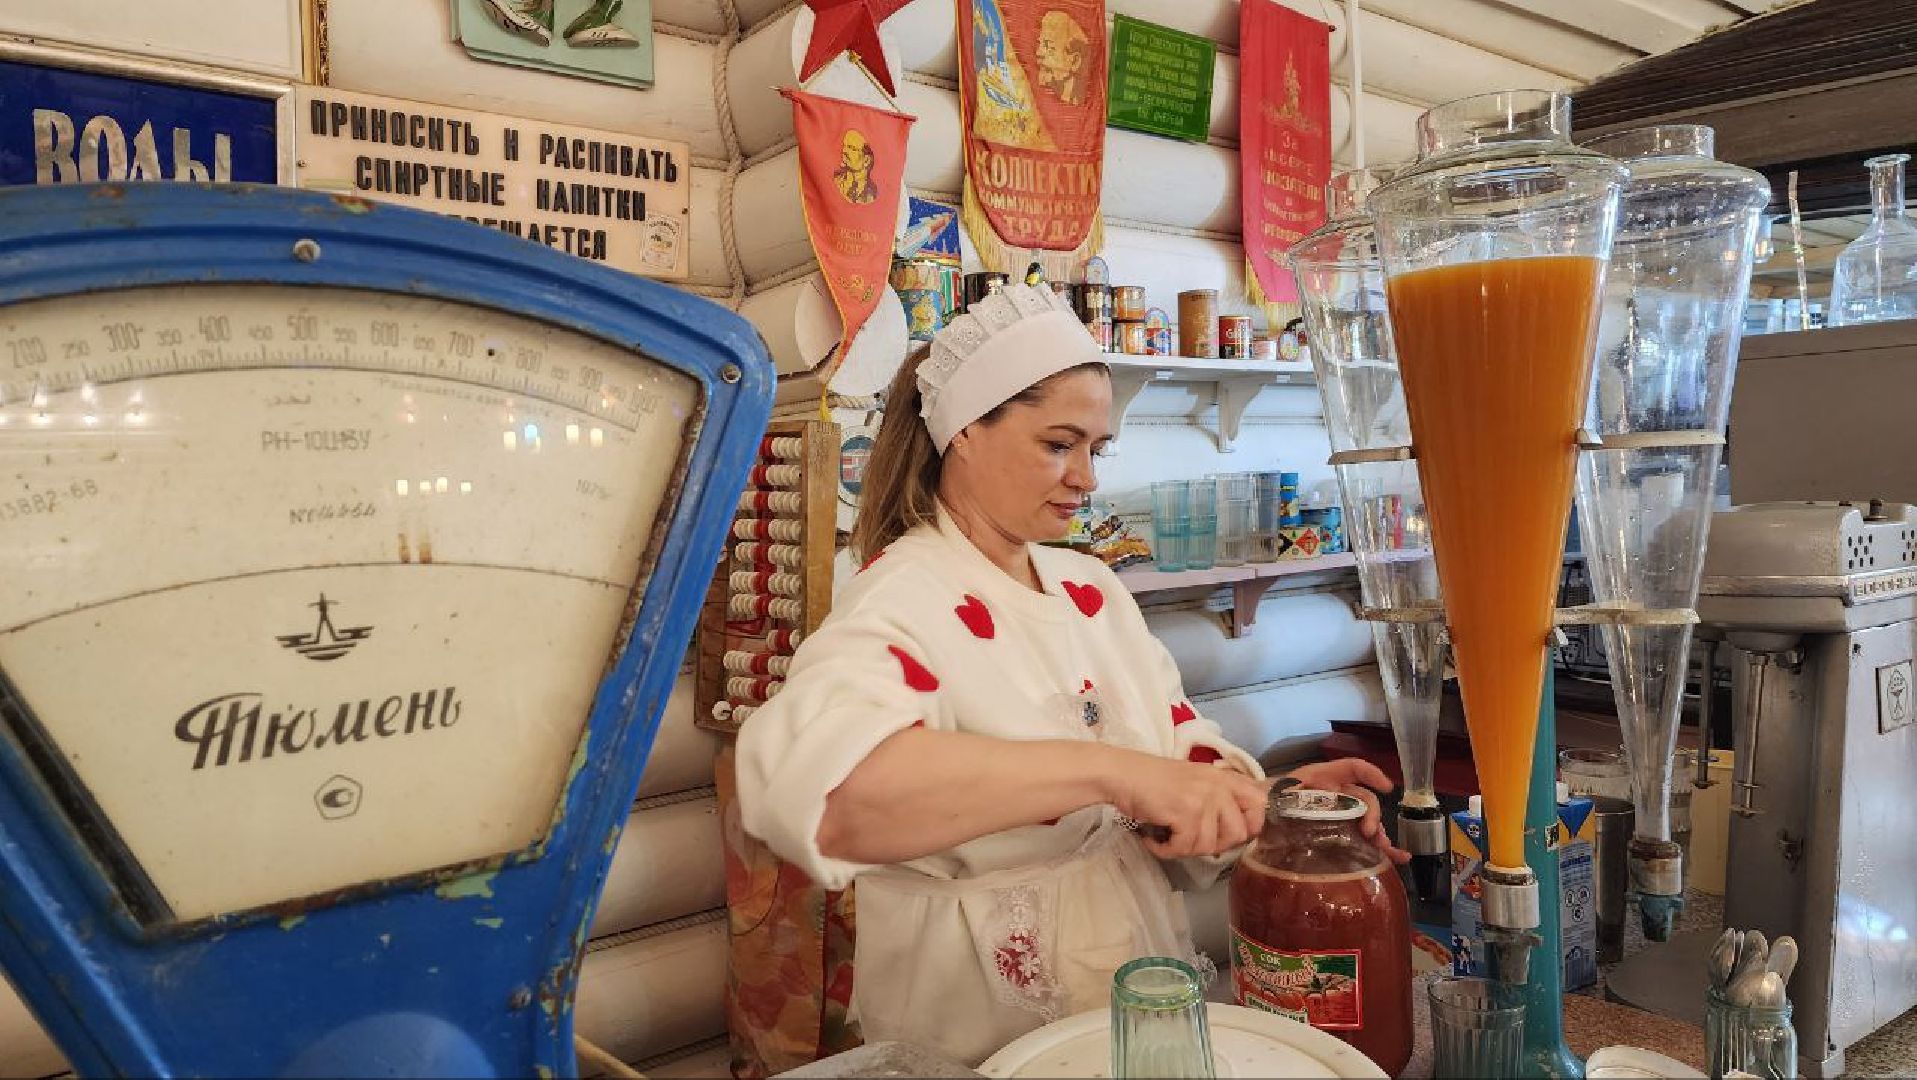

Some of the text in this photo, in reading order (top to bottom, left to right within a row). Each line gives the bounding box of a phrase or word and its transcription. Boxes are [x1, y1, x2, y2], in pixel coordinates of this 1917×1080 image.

[311, 99, 677, 183] ПРИНОСИТЬ И РАСПИВАТЬ
[356, 155, 646, 222] СПИРТНЫЕ НАПИТКИ
[975, 149, 1101, 196] КОЛЛЕКТИ
[1003, 214, 1081, 242] ТРУДА
[6, 337, 47, 368] 200
[102, 322, 141, 352] 300
[156, 328, 182, 347] 350
[199, 315, 231, 342] 400
[287, 313, 319, 342] 500
[371, 320, 400, 347] 600
[449, 330, 475, 359] 700
[174, 686, 463, 770] Тюмень
[1260, 953, 1281, 967] СОК
